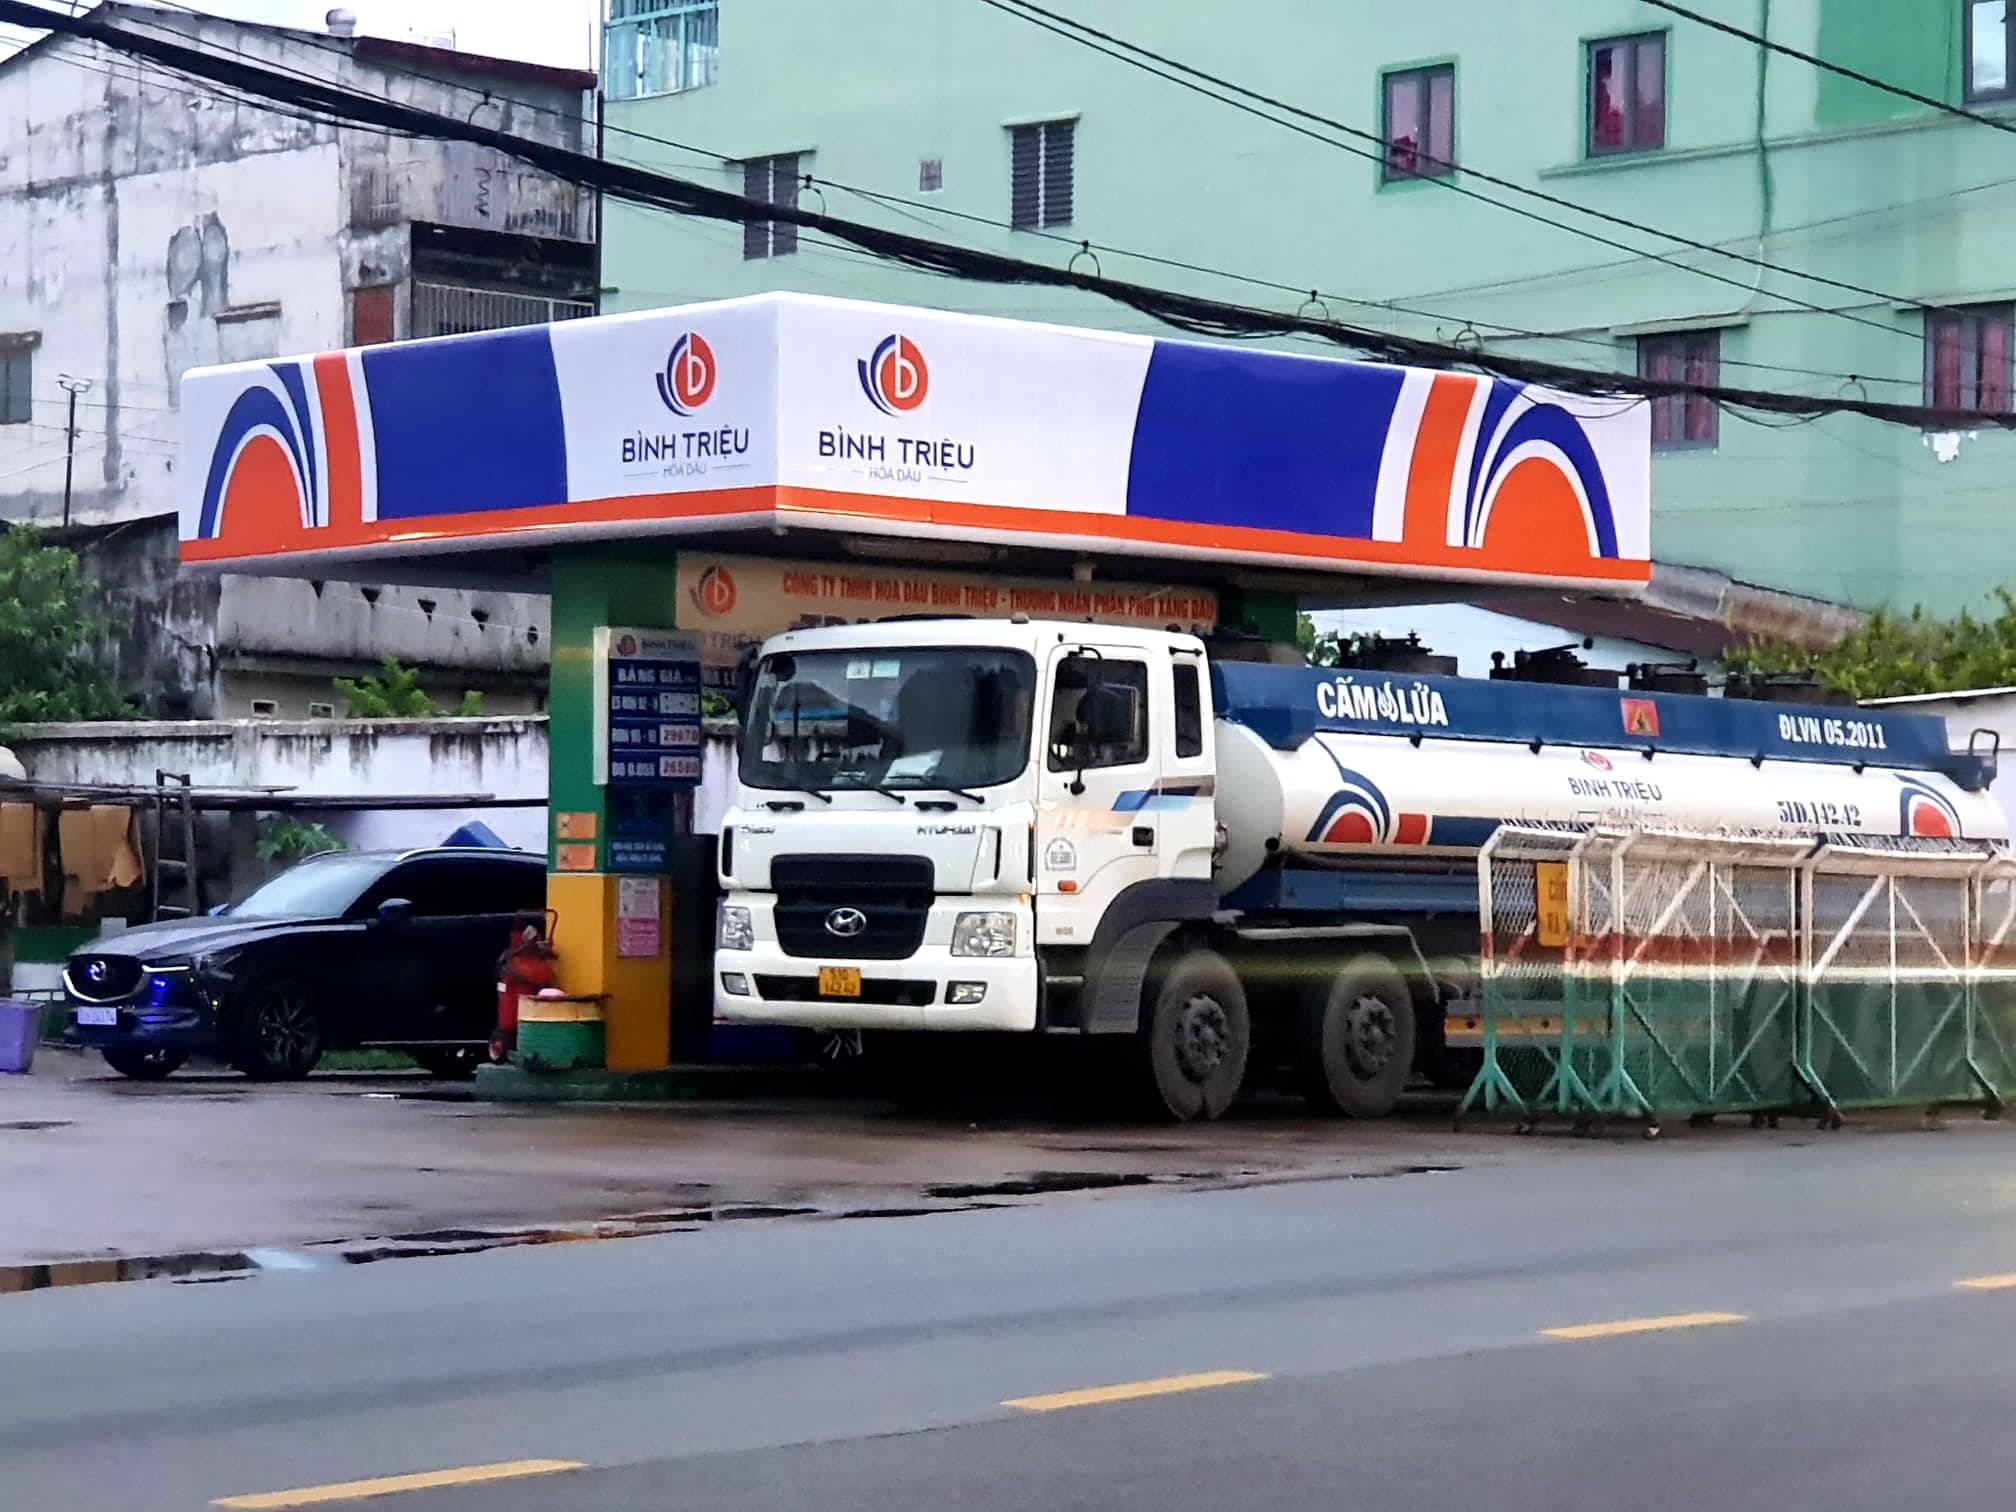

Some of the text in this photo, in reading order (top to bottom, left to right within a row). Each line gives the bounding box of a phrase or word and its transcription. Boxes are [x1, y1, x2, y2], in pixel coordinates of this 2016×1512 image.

[622, 423, 749, 463] BÌNH TRIỆU
[819, 425, 974, 472] BÌNH TRIỆU
[821, 575, 838, 597] TY
[1316, 675, 1449, 726] CẤM LỬA
[1823, 718, 1887, 749] 05.2011
